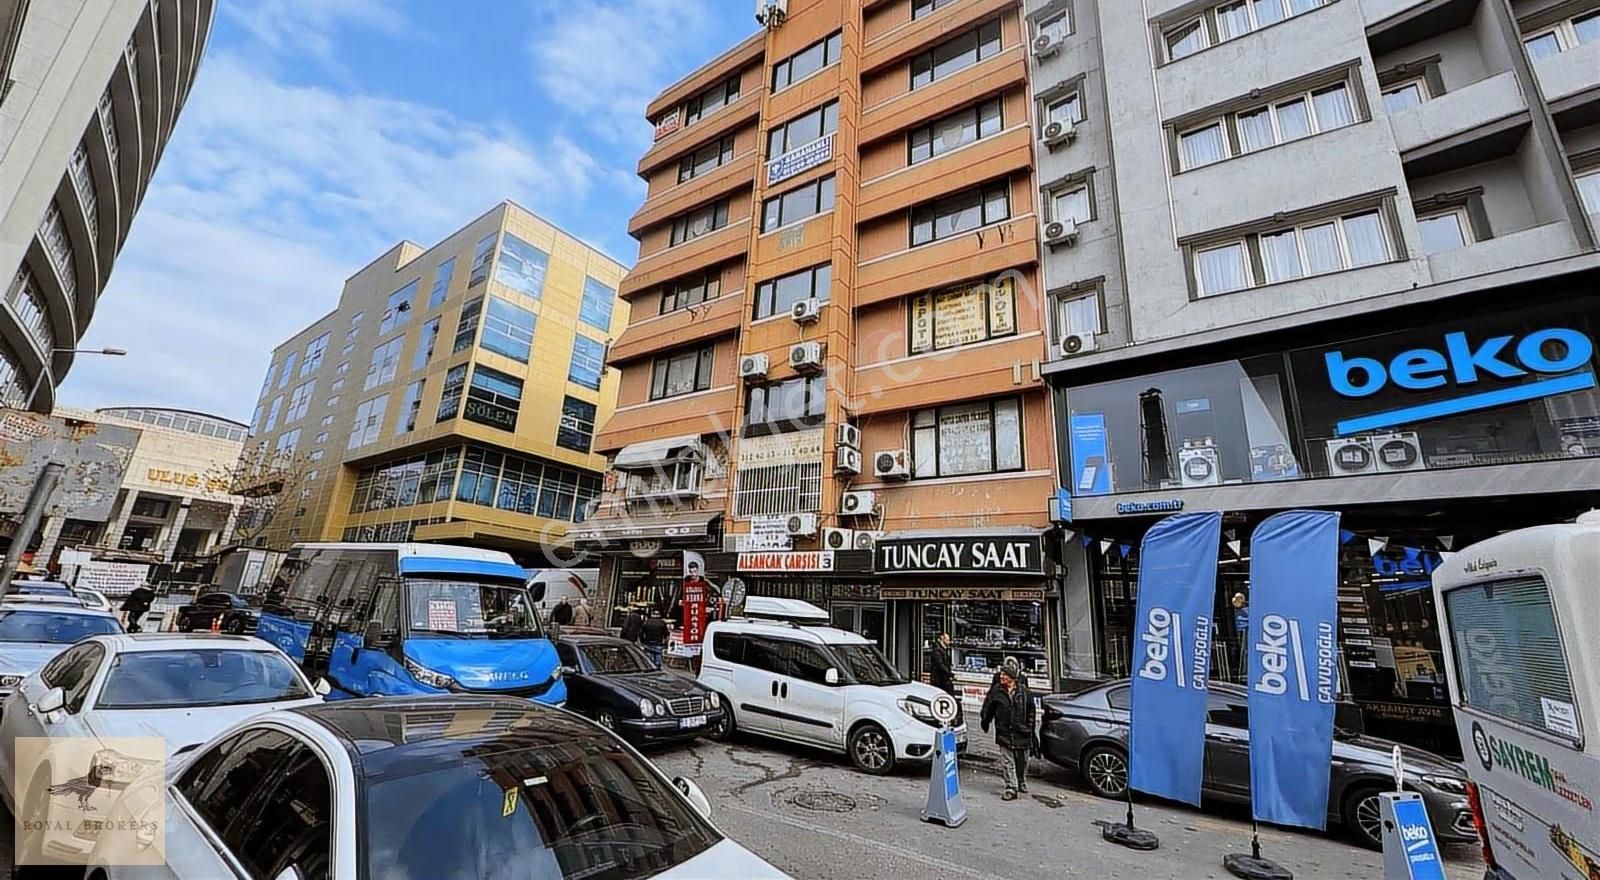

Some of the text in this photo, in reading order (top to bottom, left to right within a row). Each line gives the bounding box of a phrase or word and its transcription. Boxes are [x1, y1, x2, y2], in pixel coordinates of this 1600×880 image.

[1324, 328, 1593, 397] beko
[1117, 499, 1184, 513] beko.com.tr
[822, 558, 832, 569] 3
[882, 542, 1030, 568] TUNCAY SAAT
[908, 590, 965, 599] TUNCAY
[968, 590, 1004, 599] SAAT
[1140, 607, 1171, 681] beko
[1255, 614, 1288, 695] beko
[1318, 622, 1335, 704] ÇAVUŞOĞLU
[1489, 735, 1556, 793] SAYREM
